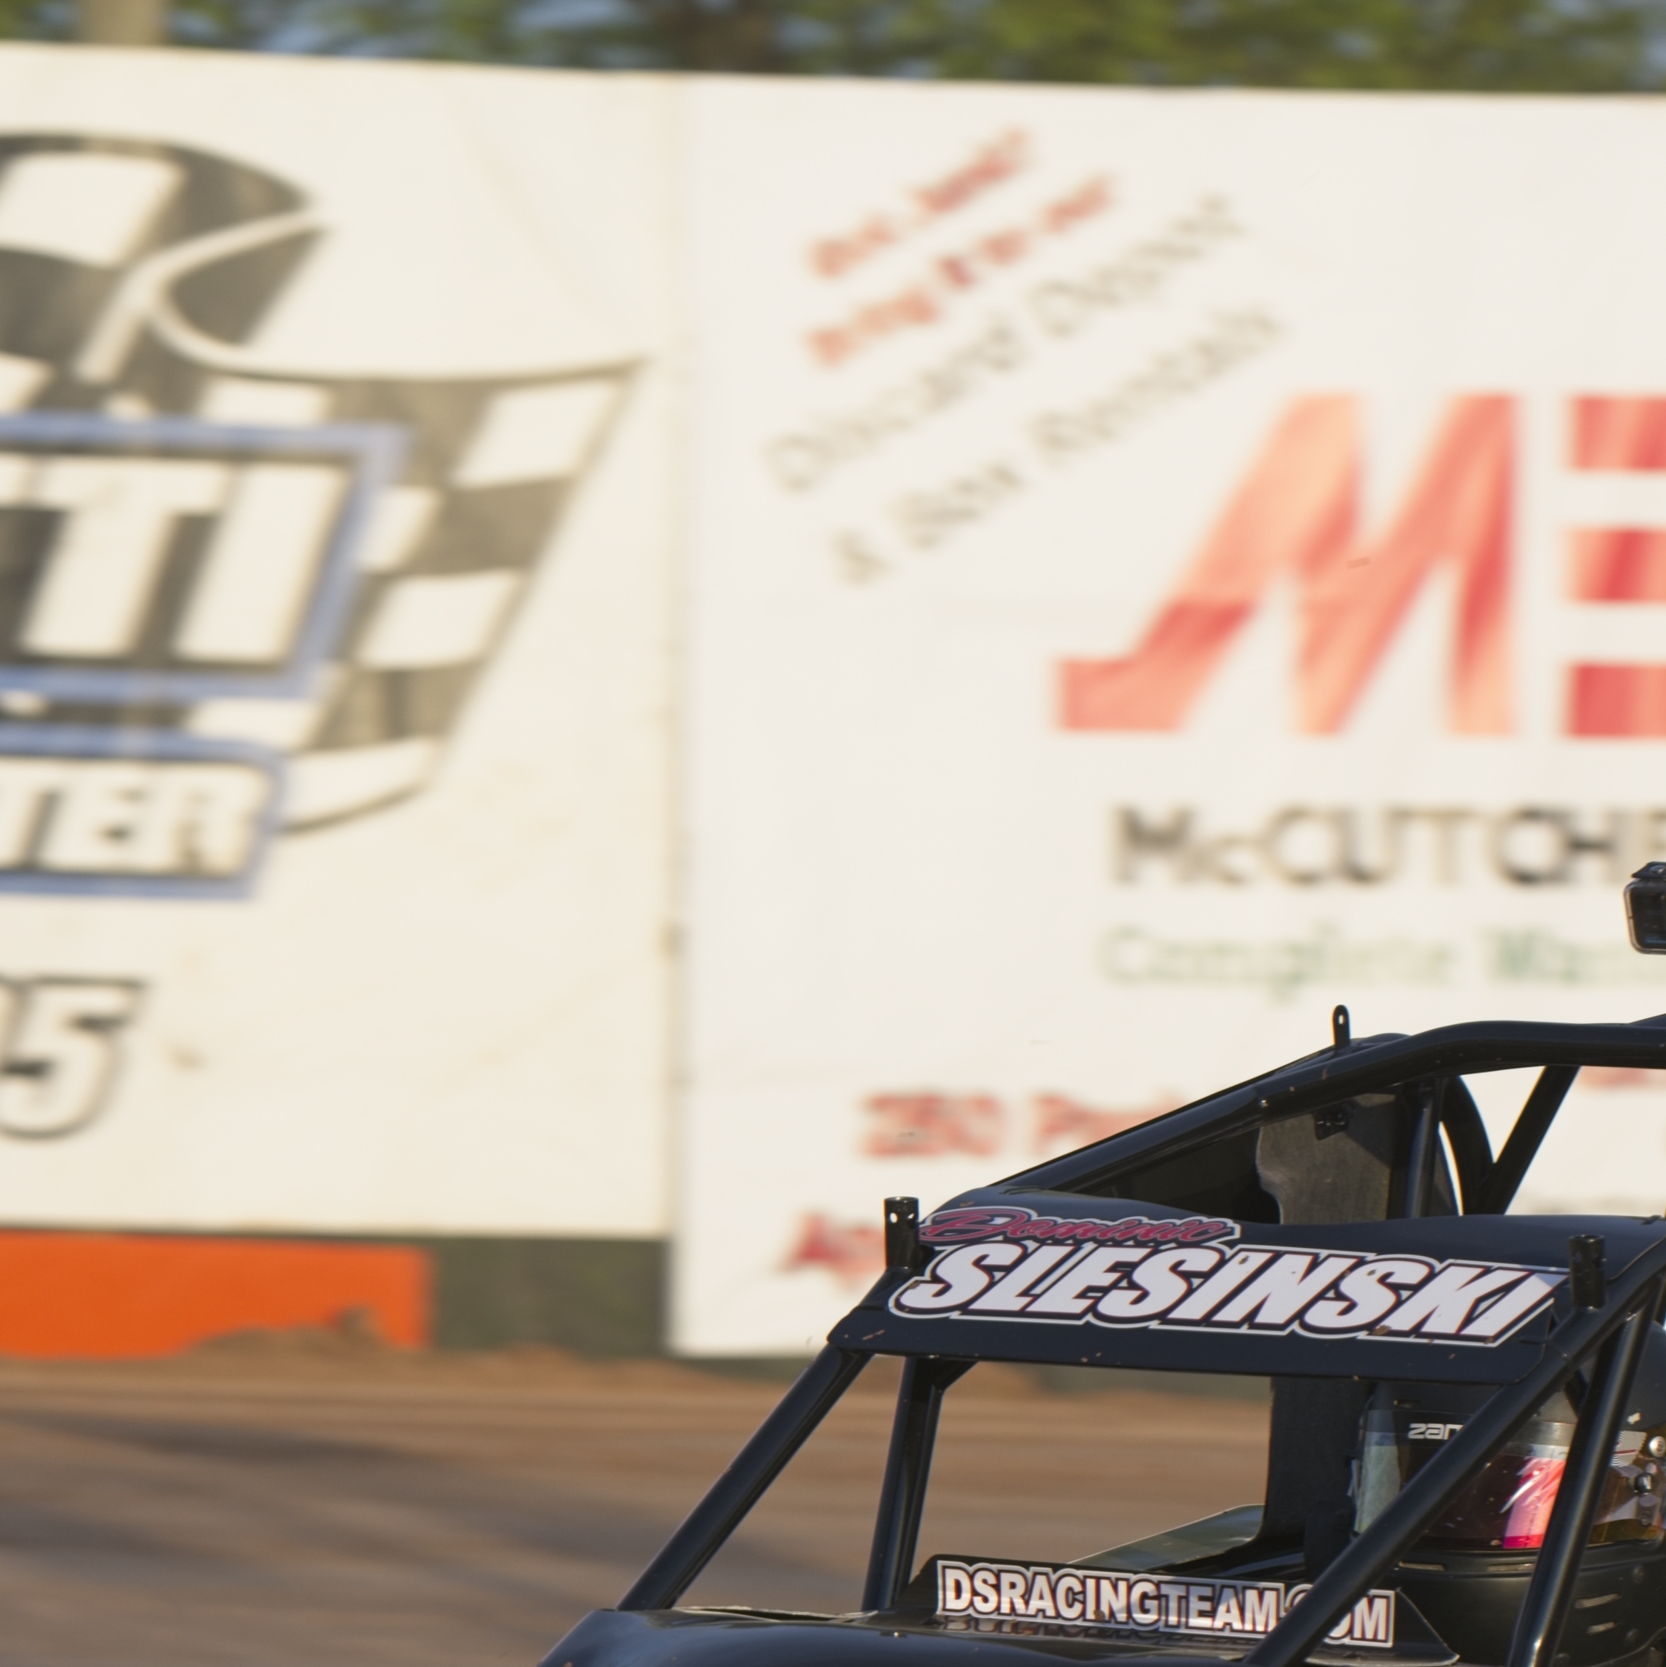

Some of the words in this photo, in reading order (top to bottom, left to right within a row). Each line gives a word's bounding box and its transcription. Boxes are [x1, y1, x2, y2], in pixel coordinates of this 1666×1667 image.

[917, 1205, 1237, 1246] Dominic
[891, 1240, 1569, 1344] SLESINSKI
[940, 1566, 1390, 1643] DSRACINGTEAMM
